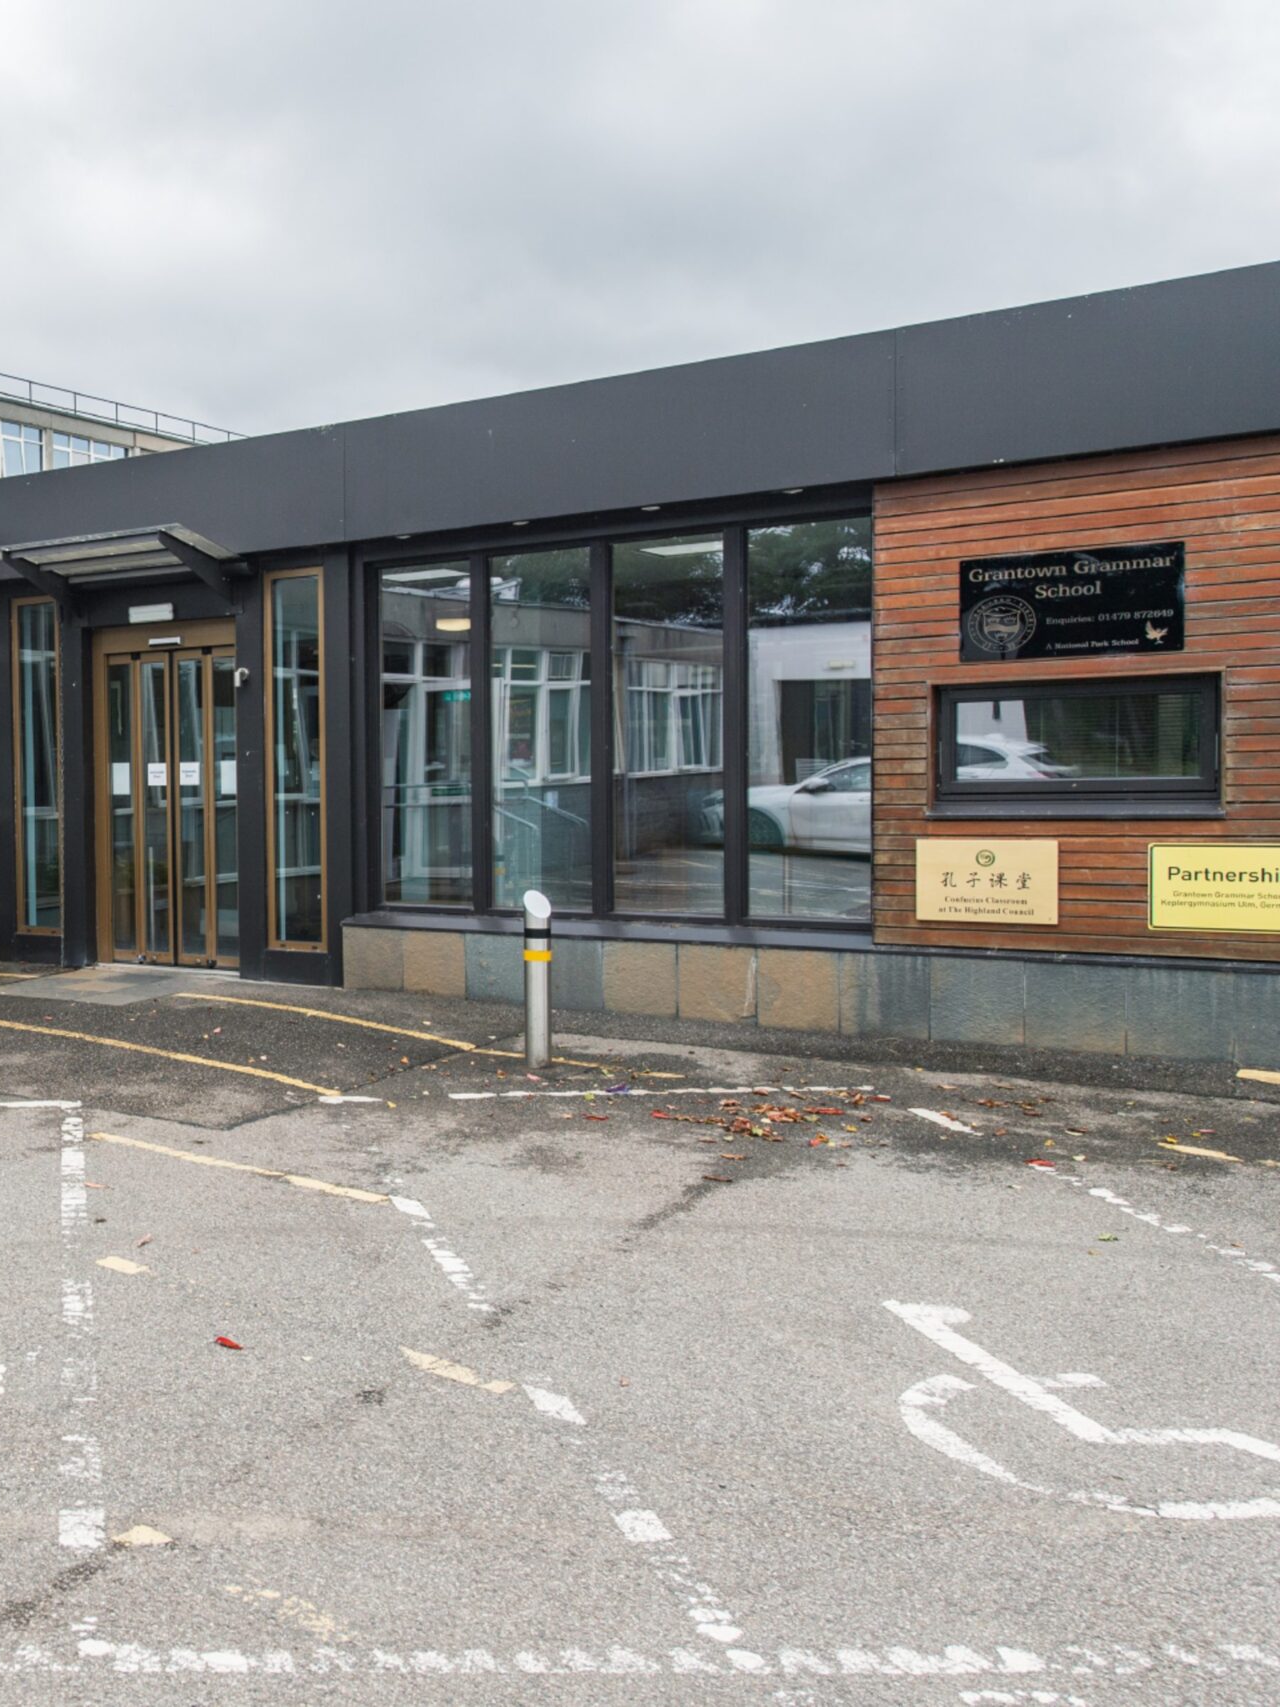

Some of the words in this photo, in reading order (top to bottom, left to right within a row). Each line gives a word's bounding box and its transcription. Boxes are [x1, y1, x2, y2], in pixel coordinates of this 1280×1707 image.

[969, 564, 1067, 583] Grantown
[1073, 555, 1175, 574] Grammar
[1034, 581, 1102, 599] School
[1046, 615, 1095, 626] Enquiries:
[1097, 612, 1131, 622] 01479
[1133, 608, 1175, 619] 872649
[1054, 641, 1089, 650] National
[1090, 640, 1109, 648] Park
[1111, 638, 1140, 647] School
[940, 871, 1032, 890] 孔子课堂
[1167, 866, 1280, 883] Partnershi
[944, 895, 984, 904] Confucius
[985, 896, 1028, 906] Classroom
[1172, 890, 1213, 899] Grantown
[1214, 891, 1255, 900] Grammar
[948, 905, 962, 914] The
[964, 906, 1001, 916] Highland
[1002, 907, 1035, 917] Council
[1160, 899, 1236, 909] Keplergymnasium
[1237, 901, 1258, 909] Ulm,
